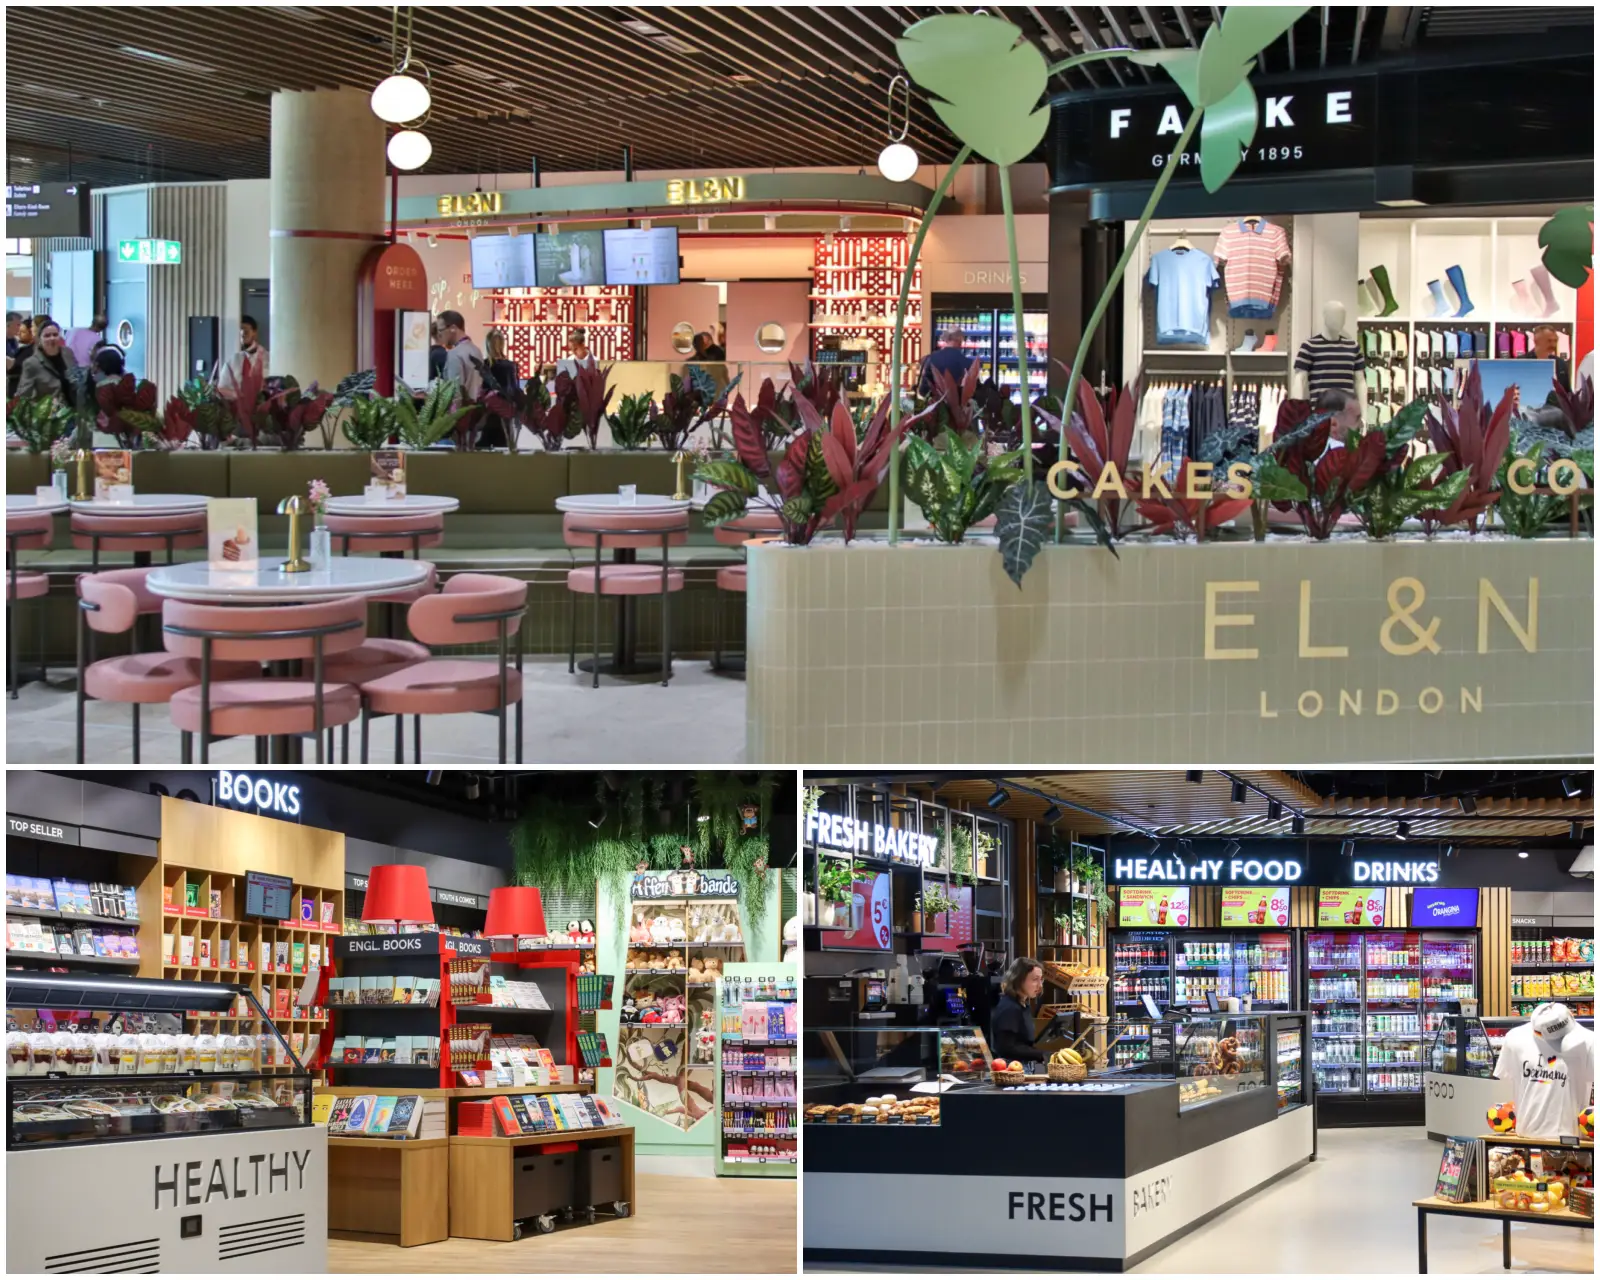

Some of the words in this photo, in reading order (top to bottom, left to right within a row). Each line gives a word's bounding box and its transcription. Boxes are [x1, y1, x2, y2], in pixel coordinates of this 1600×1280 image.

[1110, 91, 1352, 139] FAKE
[1152, 150, 1248, 167] GRMY
[1258, 146, 1303, 162] 1895
[666, 176, 745, 205] EL&N
[437, 192, 502, 217] EL&N
[389, 279, 414, 290] HERE
[1046, 460, 1254, 500] CAKES
[1204, 576, 1539, 661] EL&N
[1259, 686, 1484, 718] LONDON
[218, 770, 301, 815] BOOKS
[10, 819, 30, 832] TOP
[30, 823, 64, 839] SELLER
[805, 809, 869, 852] FRESH
[874, 822, 939, 867] BAKERY
[1231, 859, 1303, 881] FOOD
[1354, 859, 1440, 882] DRINKS
[353, 877, 365, 889] TOP
[632, 876, 671, 898] Affen
[700, 874, 738, 895] bande
[438, 892, 455, 903] YOUTH
[1512, 917, 1537, 925] SNACKS
[349, 940, 381, 952] ENGL.
[383, 938, 422, 951] BOOKS
[445, 941, 458, 952] NGL.
[459, 942, 482, 954] BOOKS
[1546, 1017, 1570, 1035] GERMAN
[1537, 1053, 1543, 1068] I
[1522, 1060, 1567, 1088] Germany
[1429, 1080, 1455, 1100] FOOD
[154, 1149, 312, 1210] HEALTHY
[1007, 1191, 1114, 1223] FRESH
